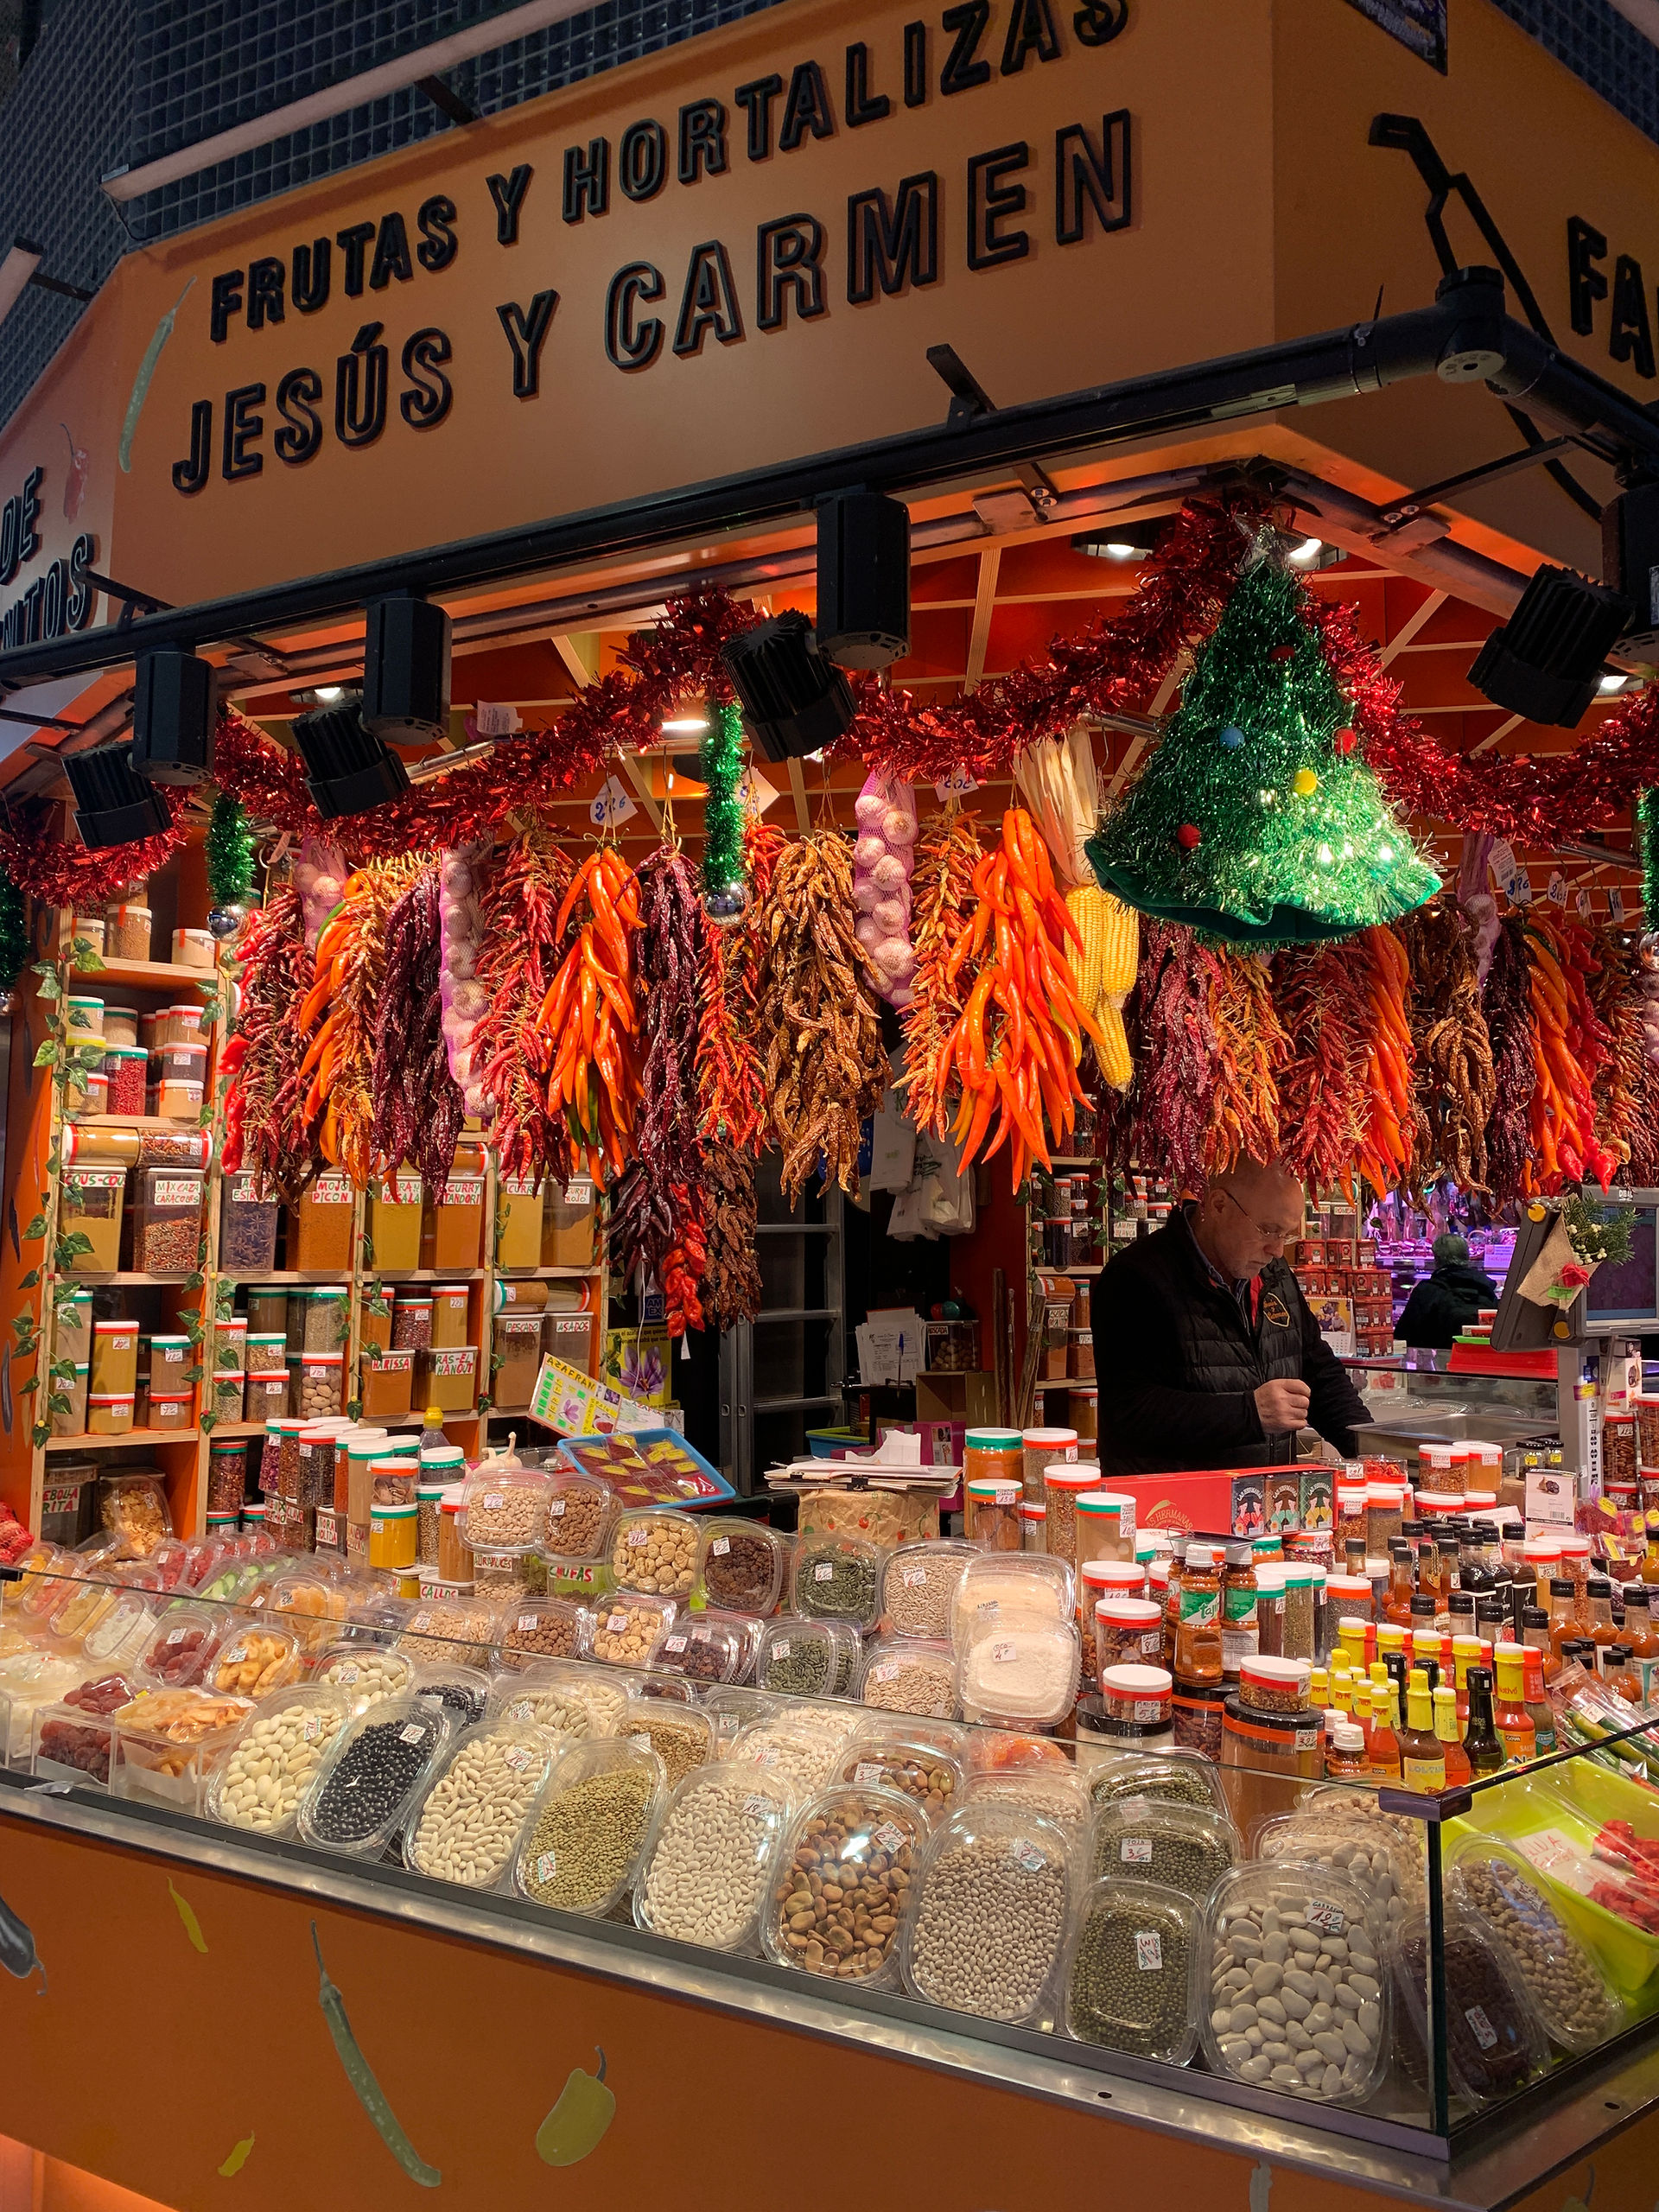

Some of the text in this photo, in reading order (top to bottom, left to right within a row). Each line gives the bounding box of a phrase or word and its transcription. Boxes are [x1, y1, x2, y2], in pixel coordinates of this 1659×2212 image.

[210, 0, 1128, 343] FRUTAS Y HORTALIZAS
[173, 108, 1133, 496] JESÚS Y CARMEN
[1567, 215, 1659, 378] FA
[0, 531, 95, 650] NTOS
[64, 1173, 125, 1186] COUS-COU
[177, 1182, 199, 1193] CAZA
[318, 1181, 348, 1191] MOJO
[448, 1182, 480, 1193] CURRY
[508, 1185, 536, 1195] CURR
[313, 1192, 348, 1202] PICON
[649, 1306, 663, 1316] EX
[506, 1322, 539, 1332] PESCADO
[557, 1322, 589, 1332] ASADOS
[372, 1358, 410, 1370] HARISSA
[546, 1356, 596, 1390] AZAFRAN
[43, 1487, 78, 1500] EBOLLA
[43, 1501, 73, 1512] RITA
[550, 1566, 592, 1582] CHUFAS
